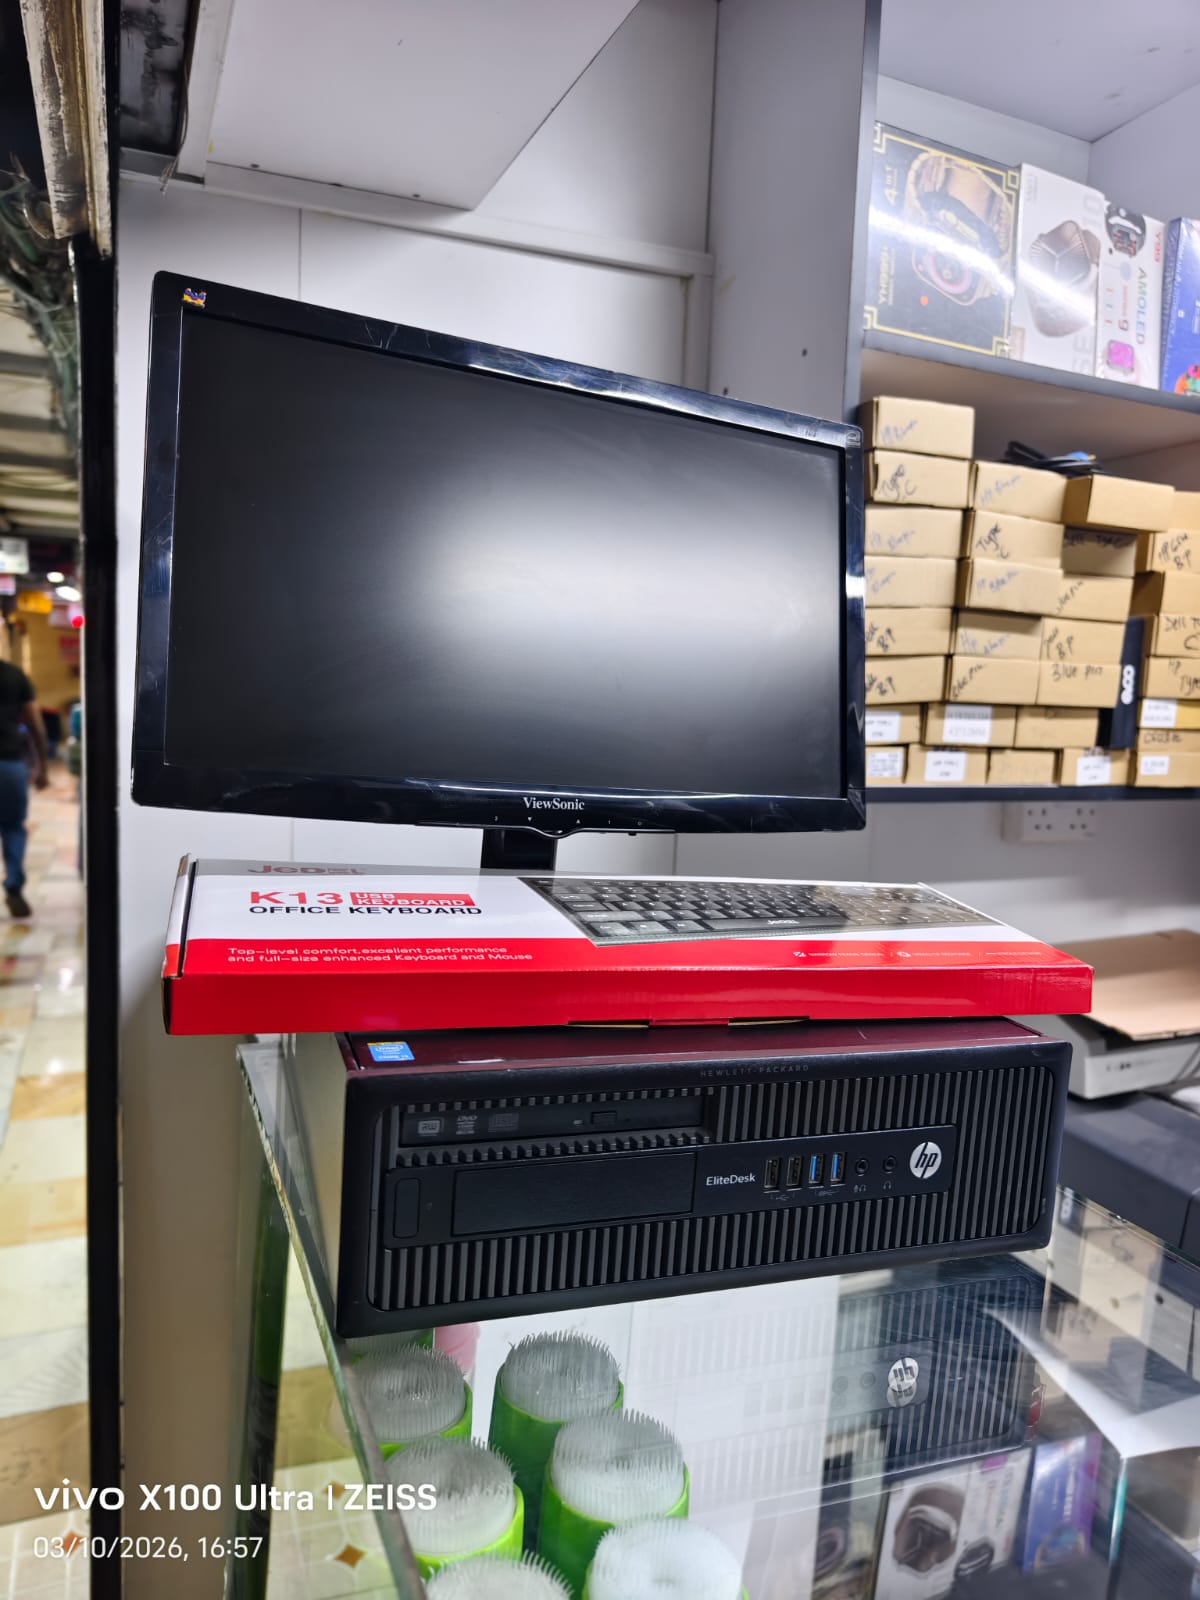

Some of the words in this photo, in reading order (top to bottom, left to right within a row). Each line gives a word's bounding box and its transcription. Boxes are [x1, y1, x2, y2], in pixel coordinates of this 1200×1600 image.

[1135, 267, 1147, 345] AMOLED
[522, 796, 585, 811] ViewSonic
[250, 891, 344, 905] K13
[249, 906, 341, 914] OFFICE
[348, 906, 483, 915] KEYBOARD
[425, 946, 508, 955] performance
[323, 954, 391, 962] enhanced
[395, 954, 458, 962] Keyboard
[911, 1142, 942, 1179] hp
[705, 1173, 756, 1187] EliteDesk
